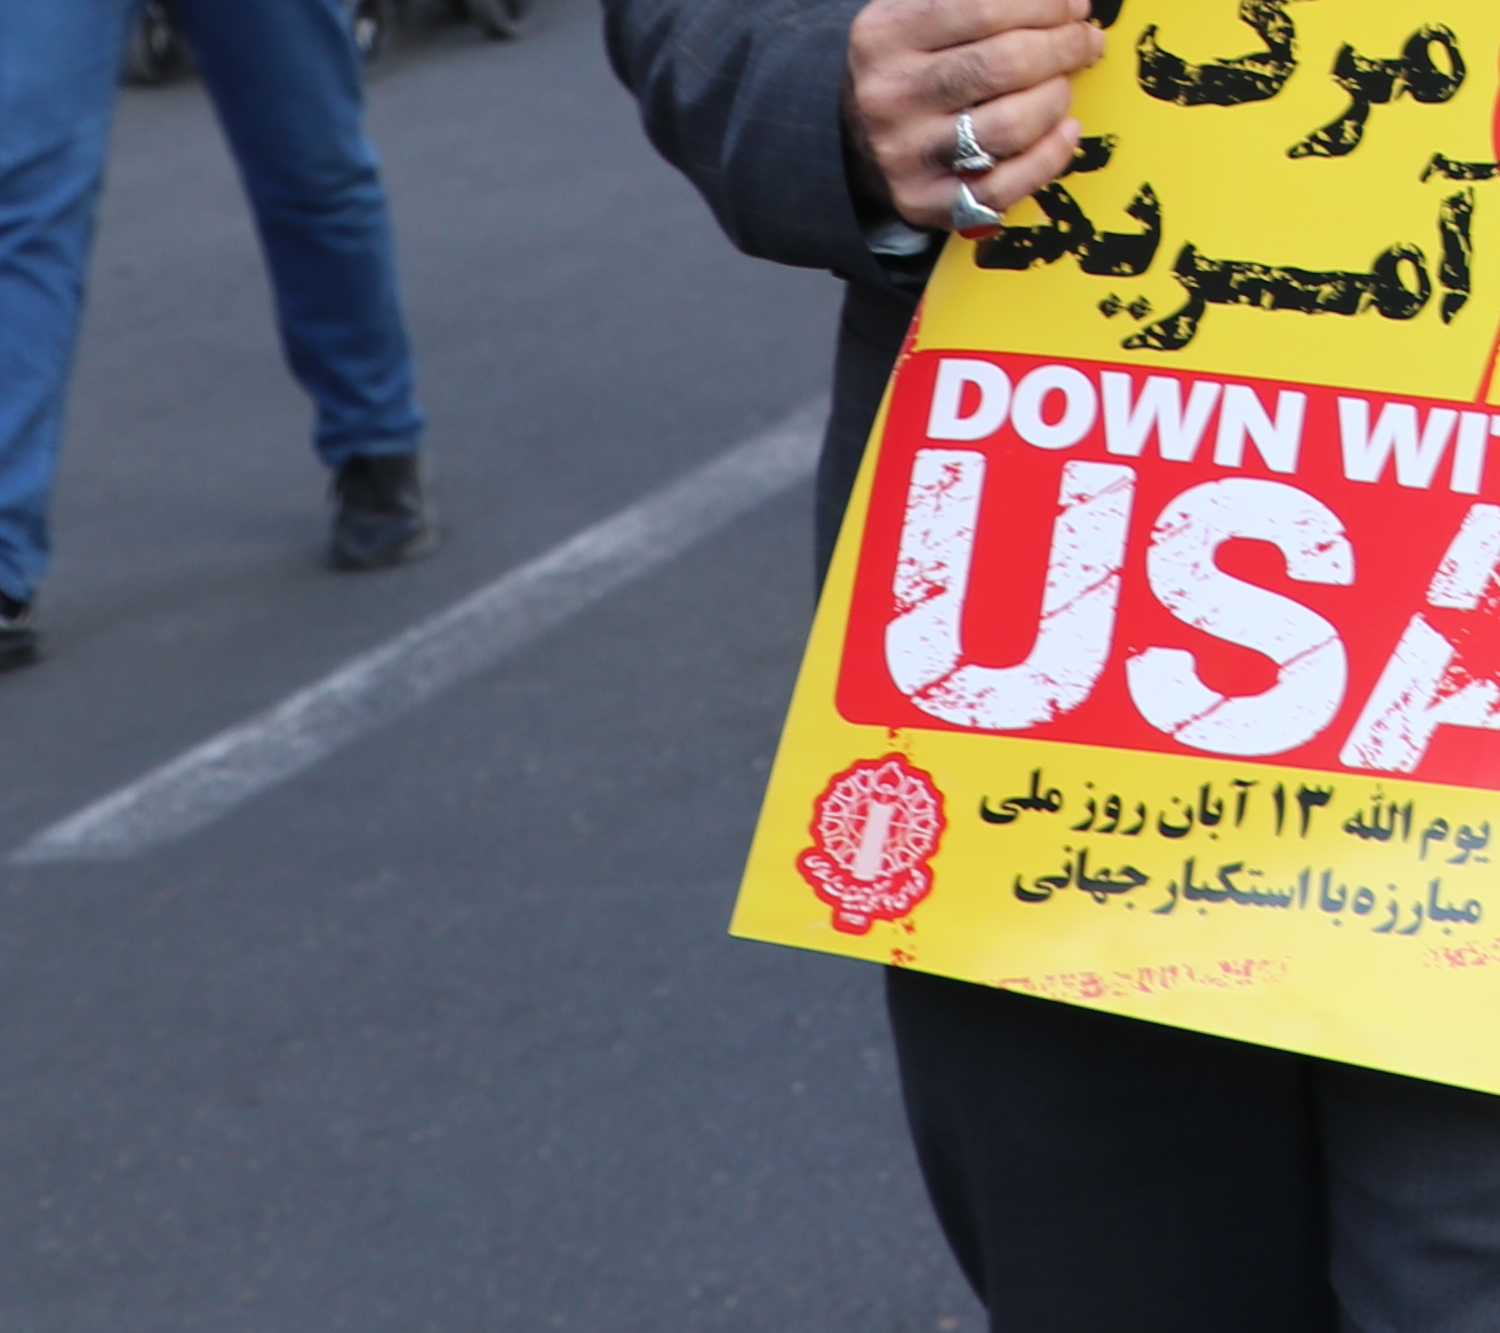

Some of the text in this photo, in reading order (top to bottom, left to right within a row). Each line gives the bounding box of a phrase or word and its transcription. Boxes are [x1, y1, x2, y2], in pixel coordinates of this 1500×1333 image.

[926, 357, 1307, 475] DOWN
[978, 767, 1492, 865] یوم الله ۱۳ آبان روز ملی
[1012, 844, 1484, 936] مبارزه با استکبار جهانی
